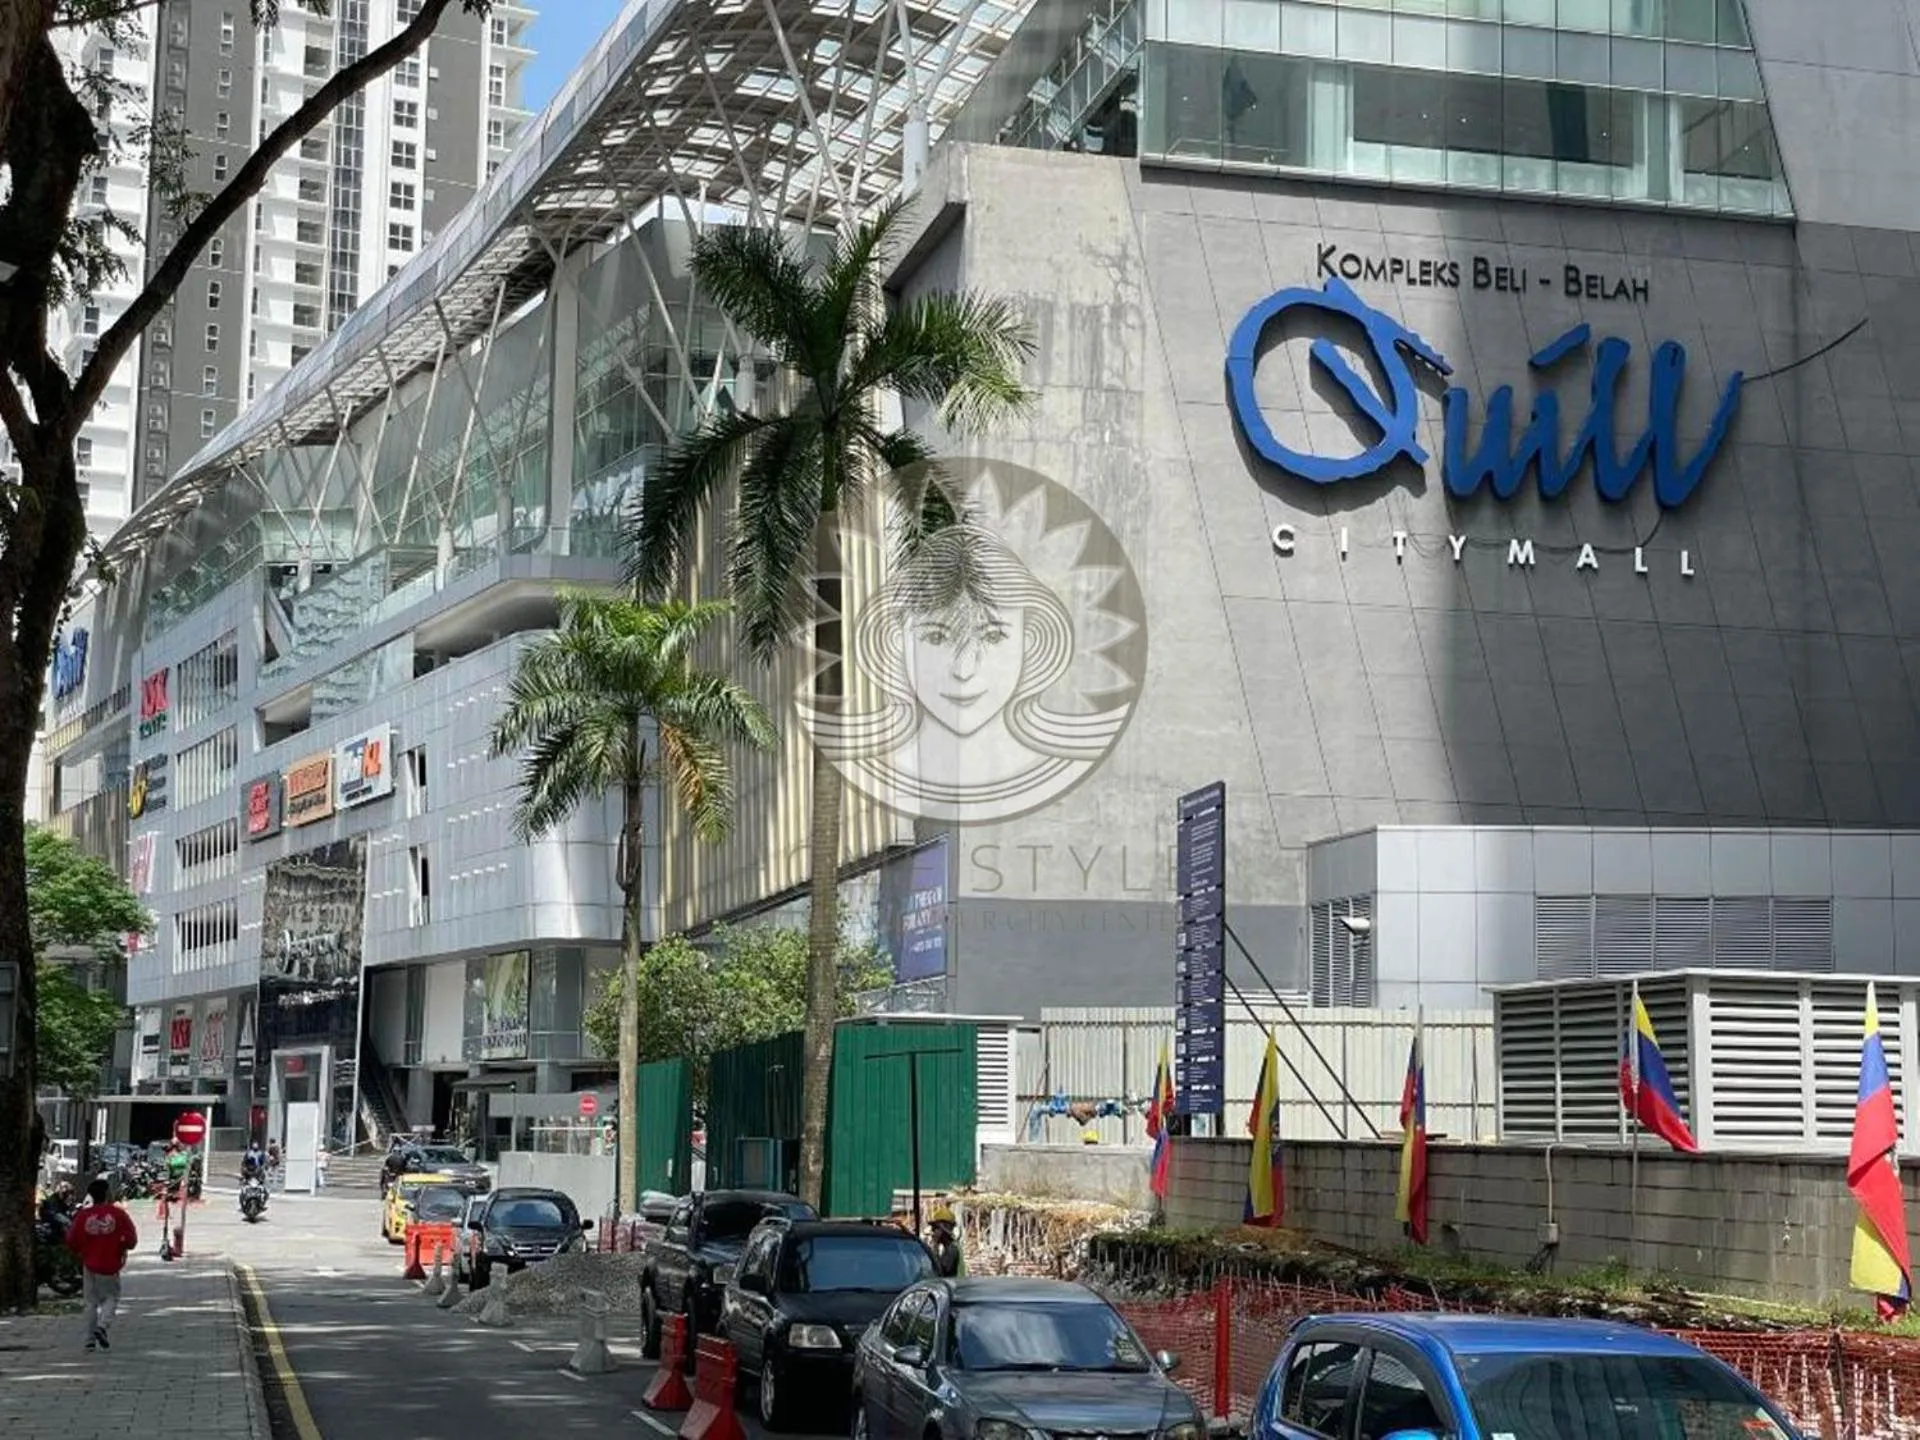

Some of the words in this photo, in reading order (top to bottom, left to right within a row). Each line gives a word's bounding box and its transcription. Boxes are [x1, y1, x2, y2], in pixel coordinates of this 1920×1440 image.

[1316, 242, 1460, 288] KOMPLEKS
[1472, 256, 1527, 294] BELI
[1563, 265, 1649, 303] BELAH
[1227, 276, 1743, 508] Quill
